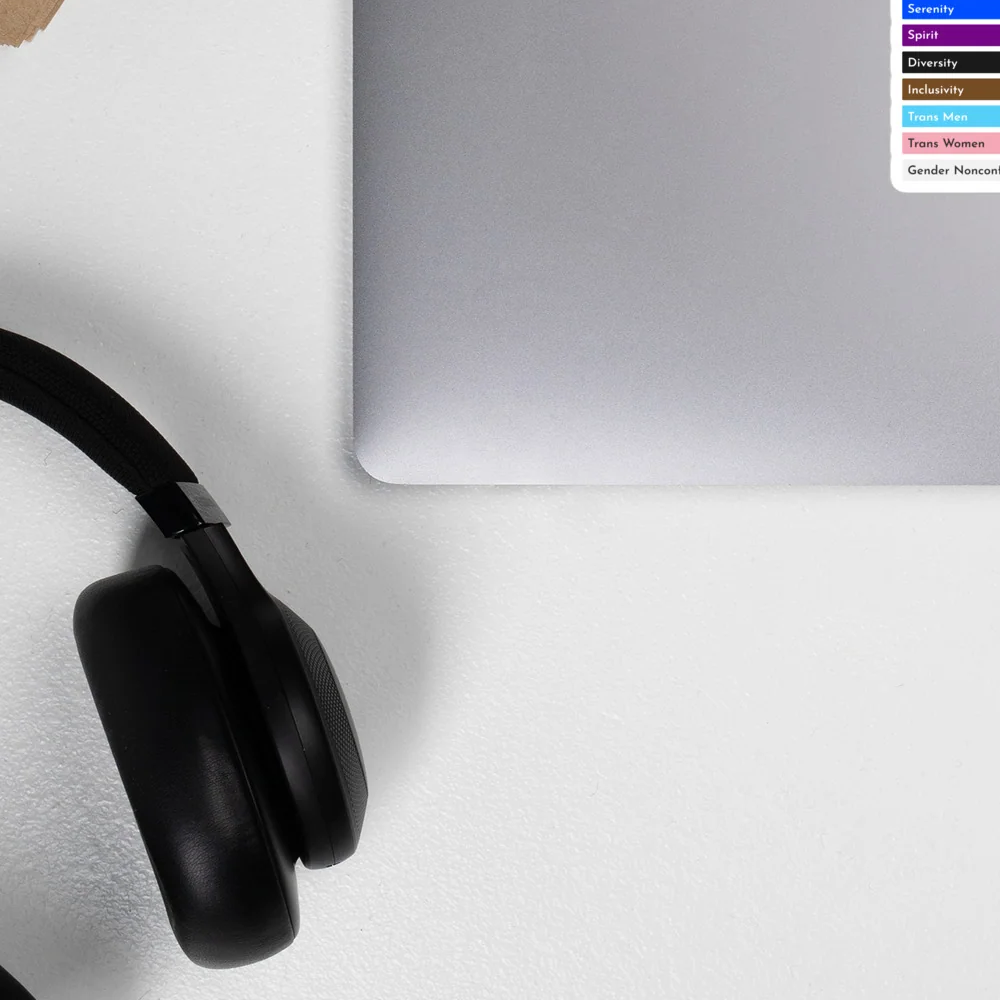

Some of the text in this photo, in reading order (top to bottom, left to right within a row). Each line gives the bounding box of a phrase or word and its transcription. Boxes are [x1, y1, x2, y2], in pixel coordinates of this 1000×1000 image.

[908, 3, 955, 16] Serenity
[908, 30, 939, 42] Spirit
[908, 57, 958, 70] Diversity
[908, 84, 964, 97] Inclusivity
[908, 111, 968, 122] Trans Men
[908, 138, 985, 149] Trans Women
[908, 164, 950, 175] Gender
